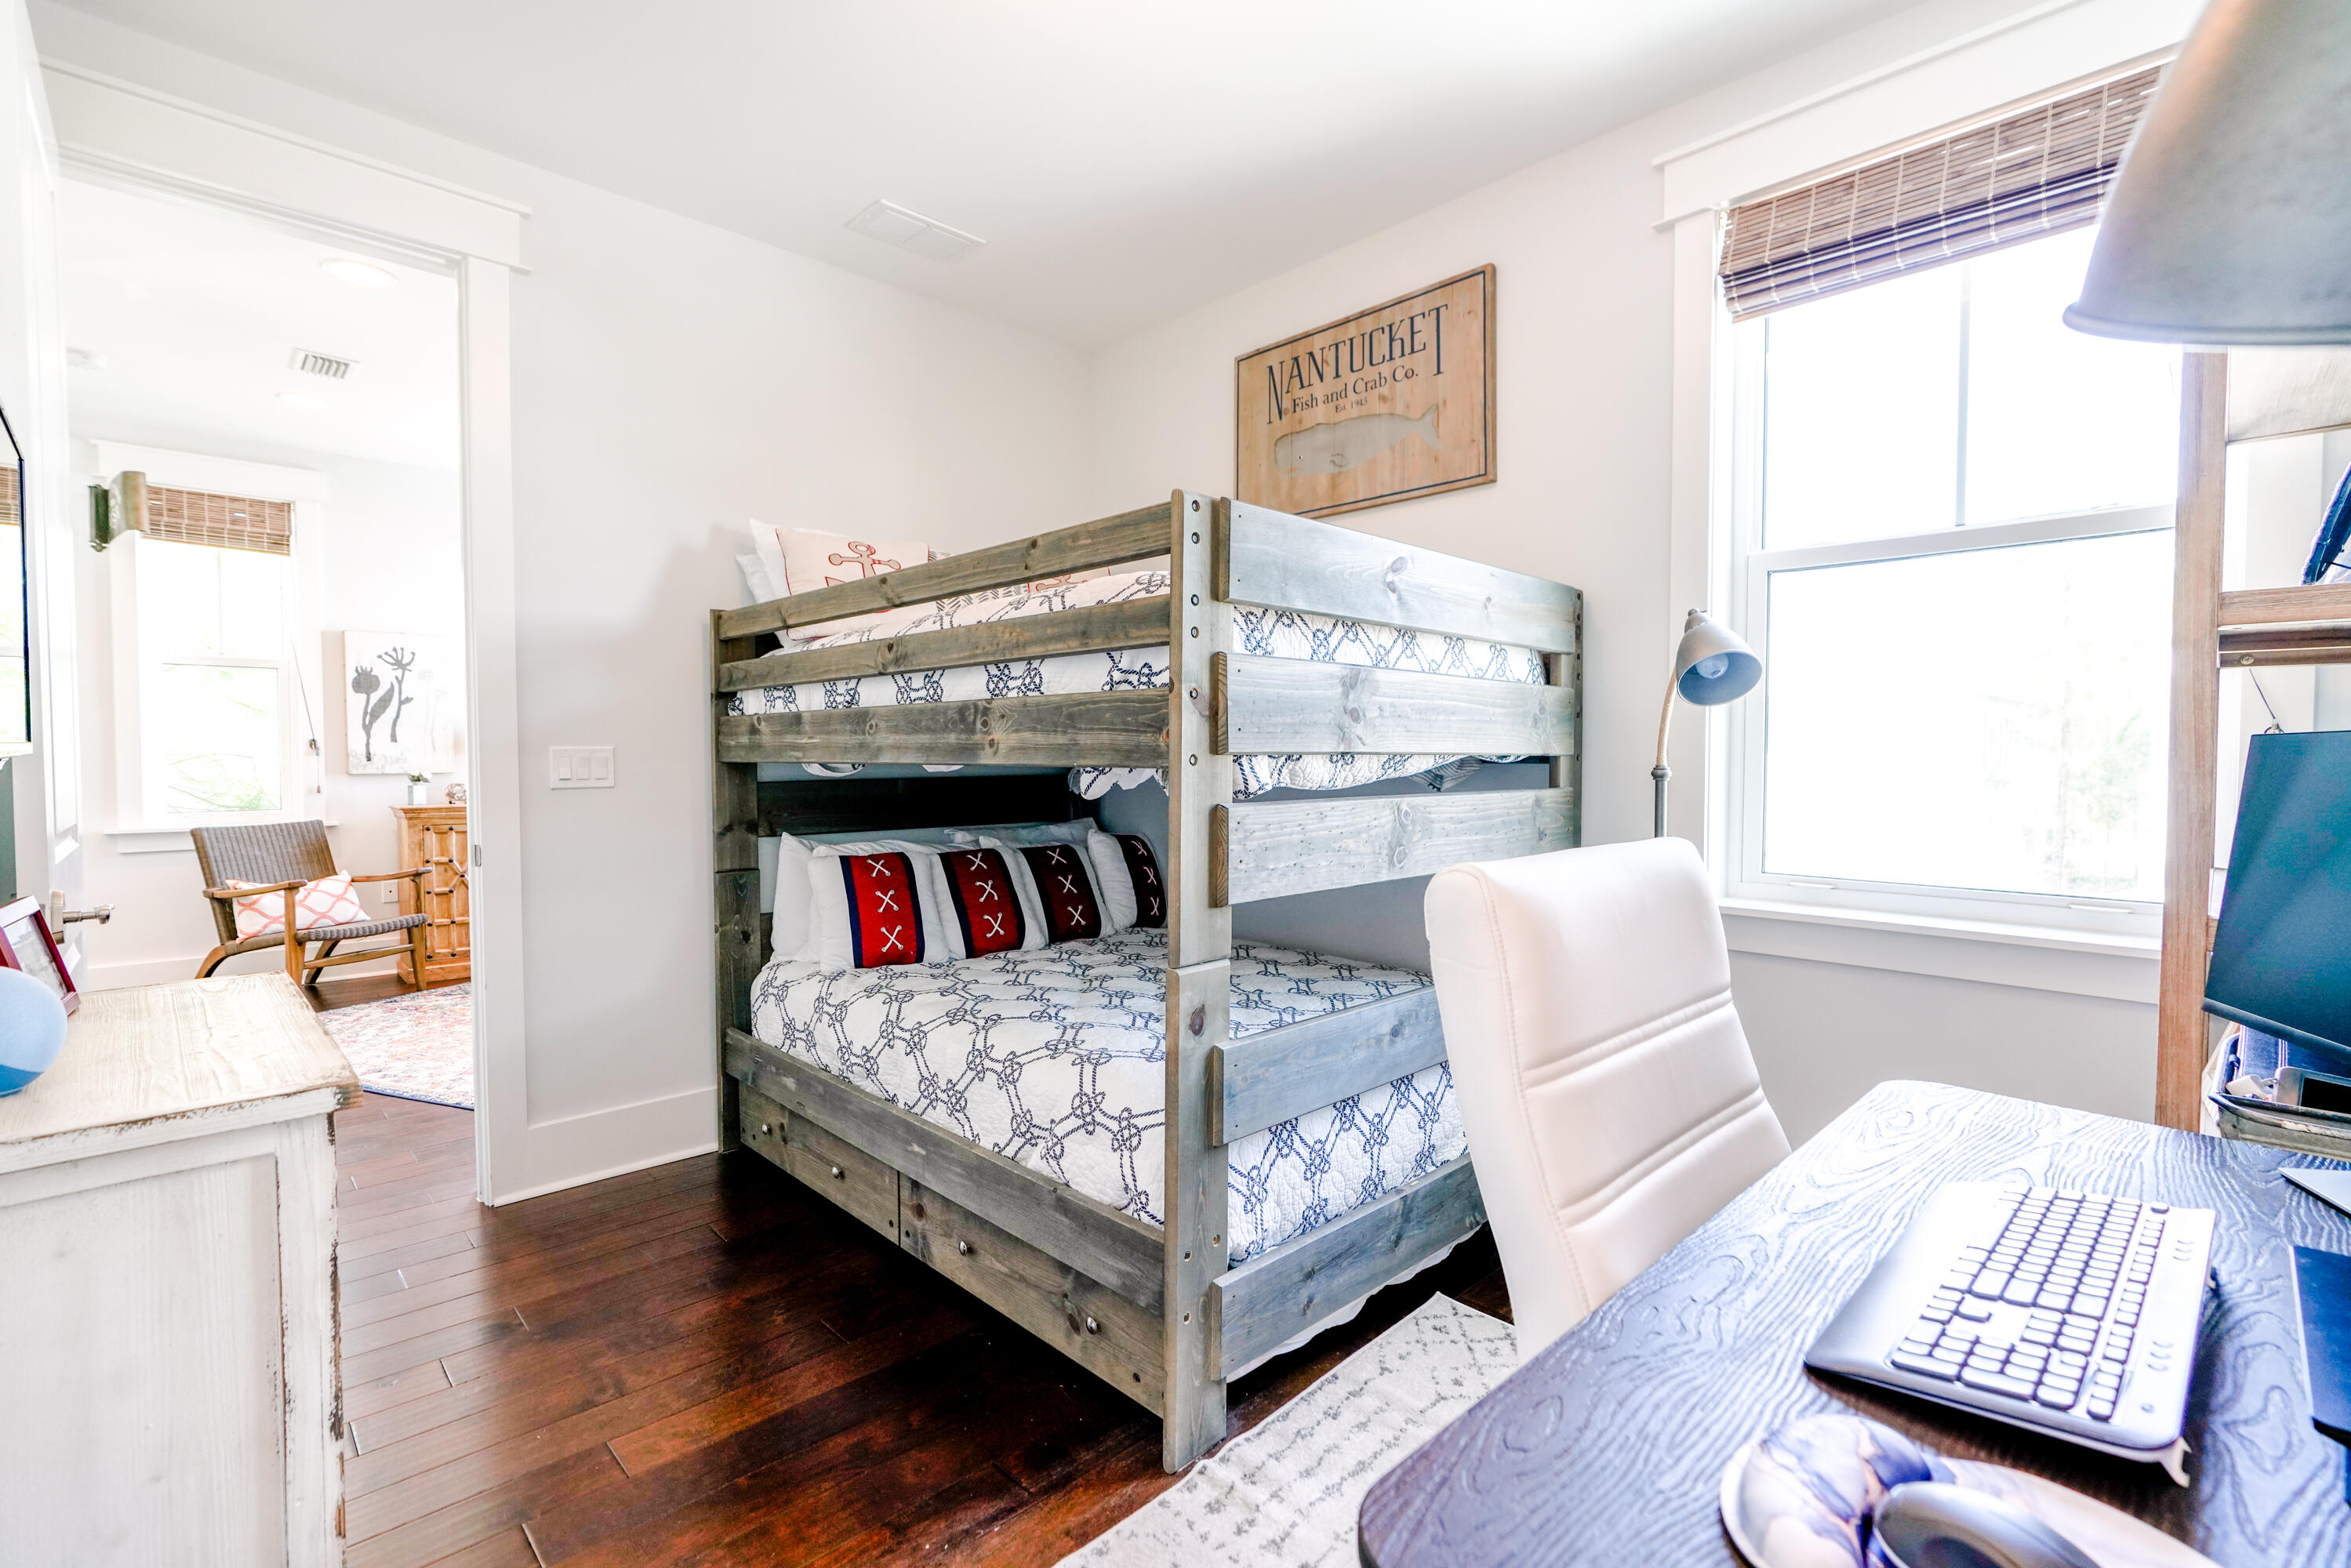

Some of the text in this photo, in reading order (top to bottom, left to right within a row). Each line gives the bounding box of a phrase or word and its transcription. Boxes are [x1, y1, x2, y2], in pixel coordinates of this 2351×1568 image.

[1266, 304, 1448, 424] NANTUCKET
[1292, 365, 1419, 414] Fish and Crab Co.
